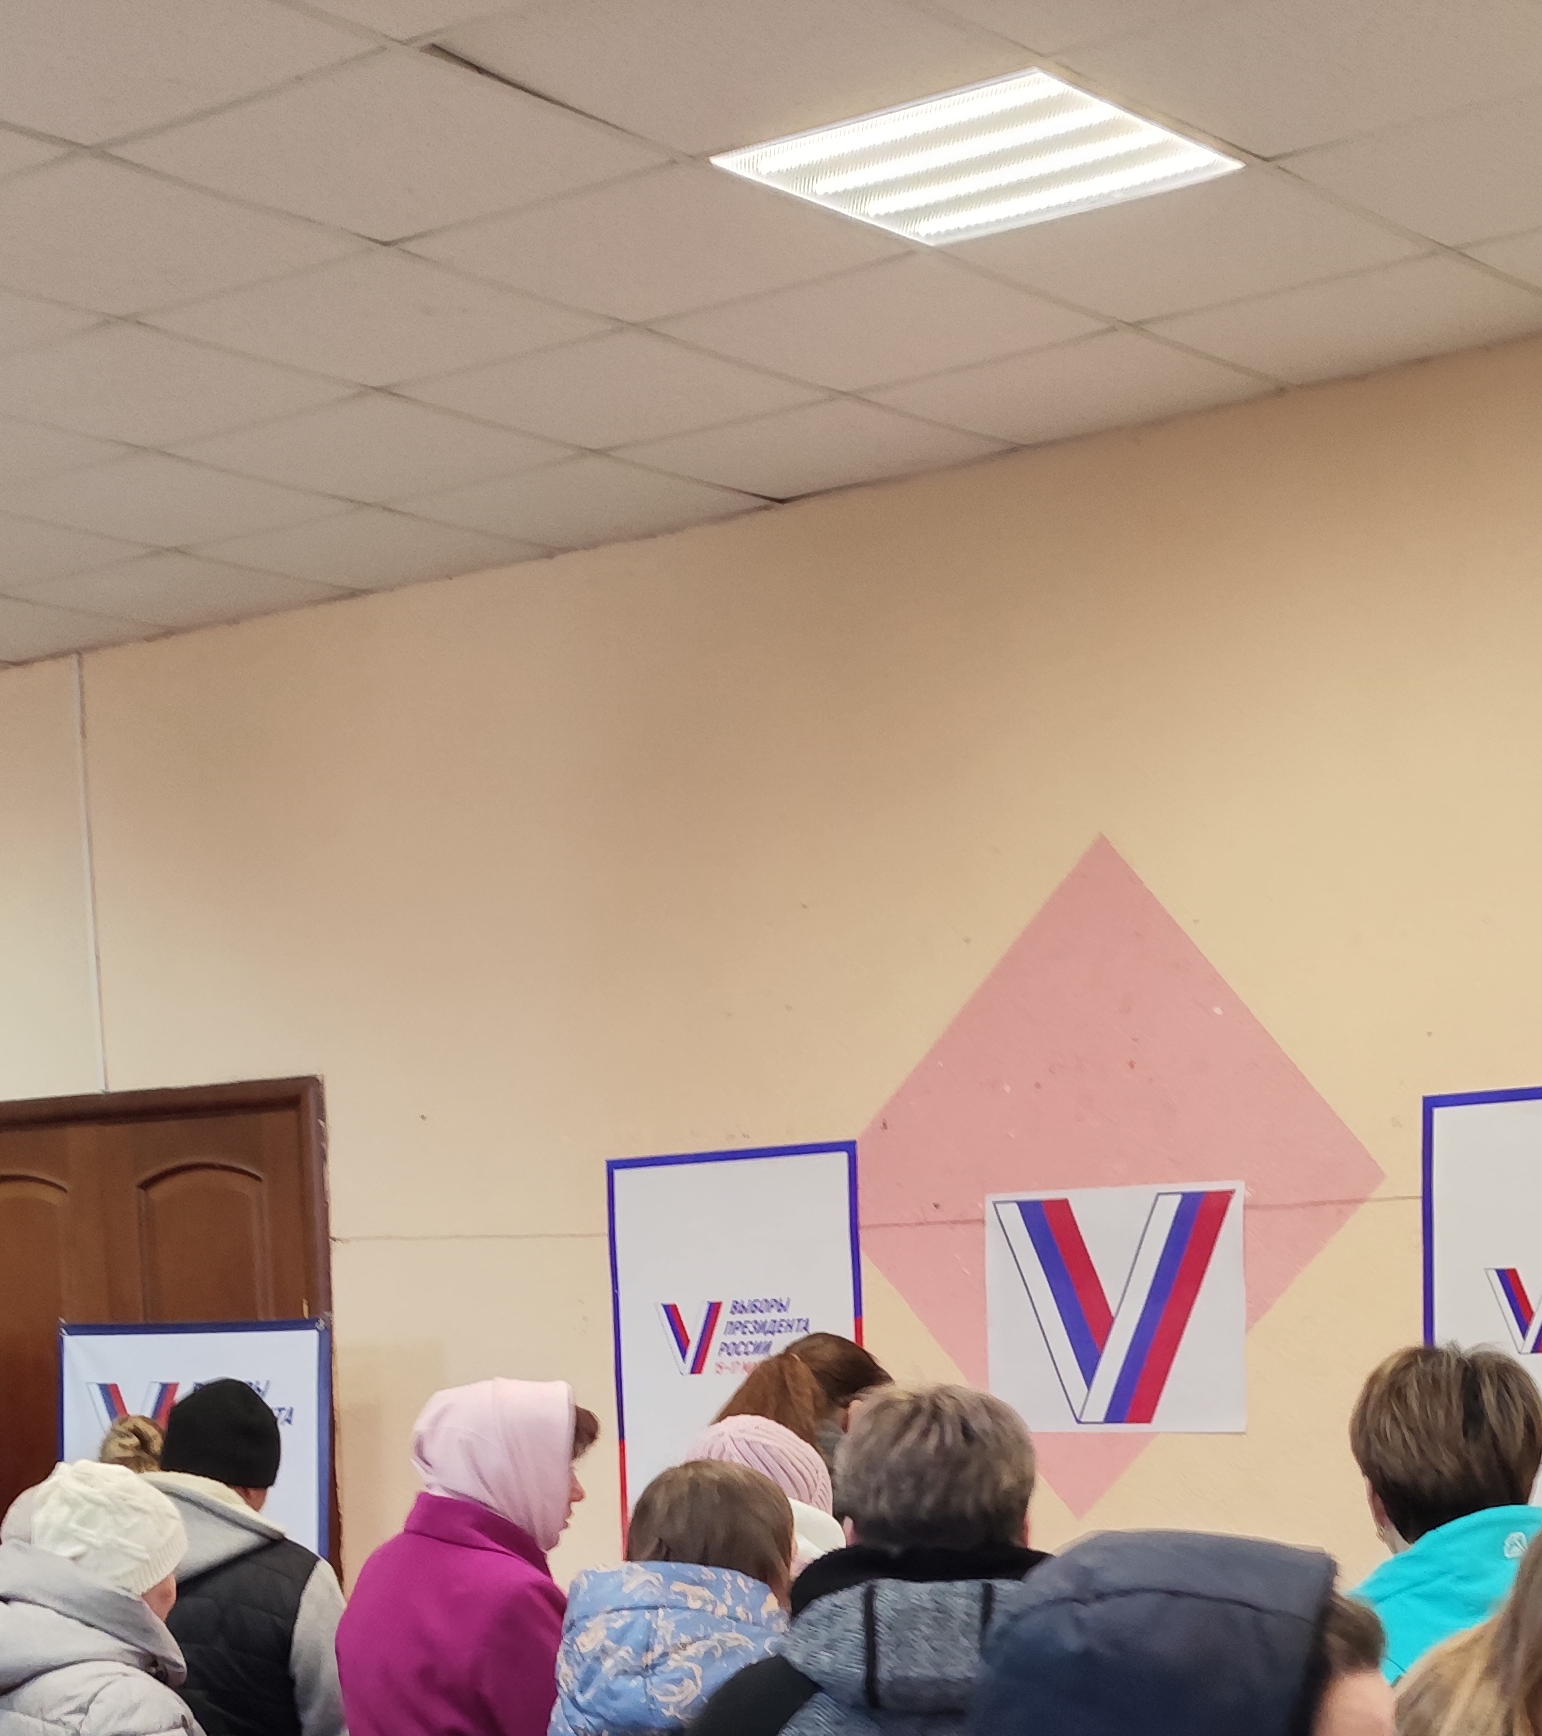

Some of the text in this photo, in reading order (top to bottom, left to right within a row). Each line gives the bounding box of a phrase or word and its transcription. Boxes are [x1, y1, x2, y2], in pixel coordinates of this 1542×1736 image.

[729, 1297, 791, 1315] ВЫБОРЫ
[723, 1318, 810, 1336] ПРЕЗИДЕНТА
[718, 1340, 773, 1357] РОССИИ
